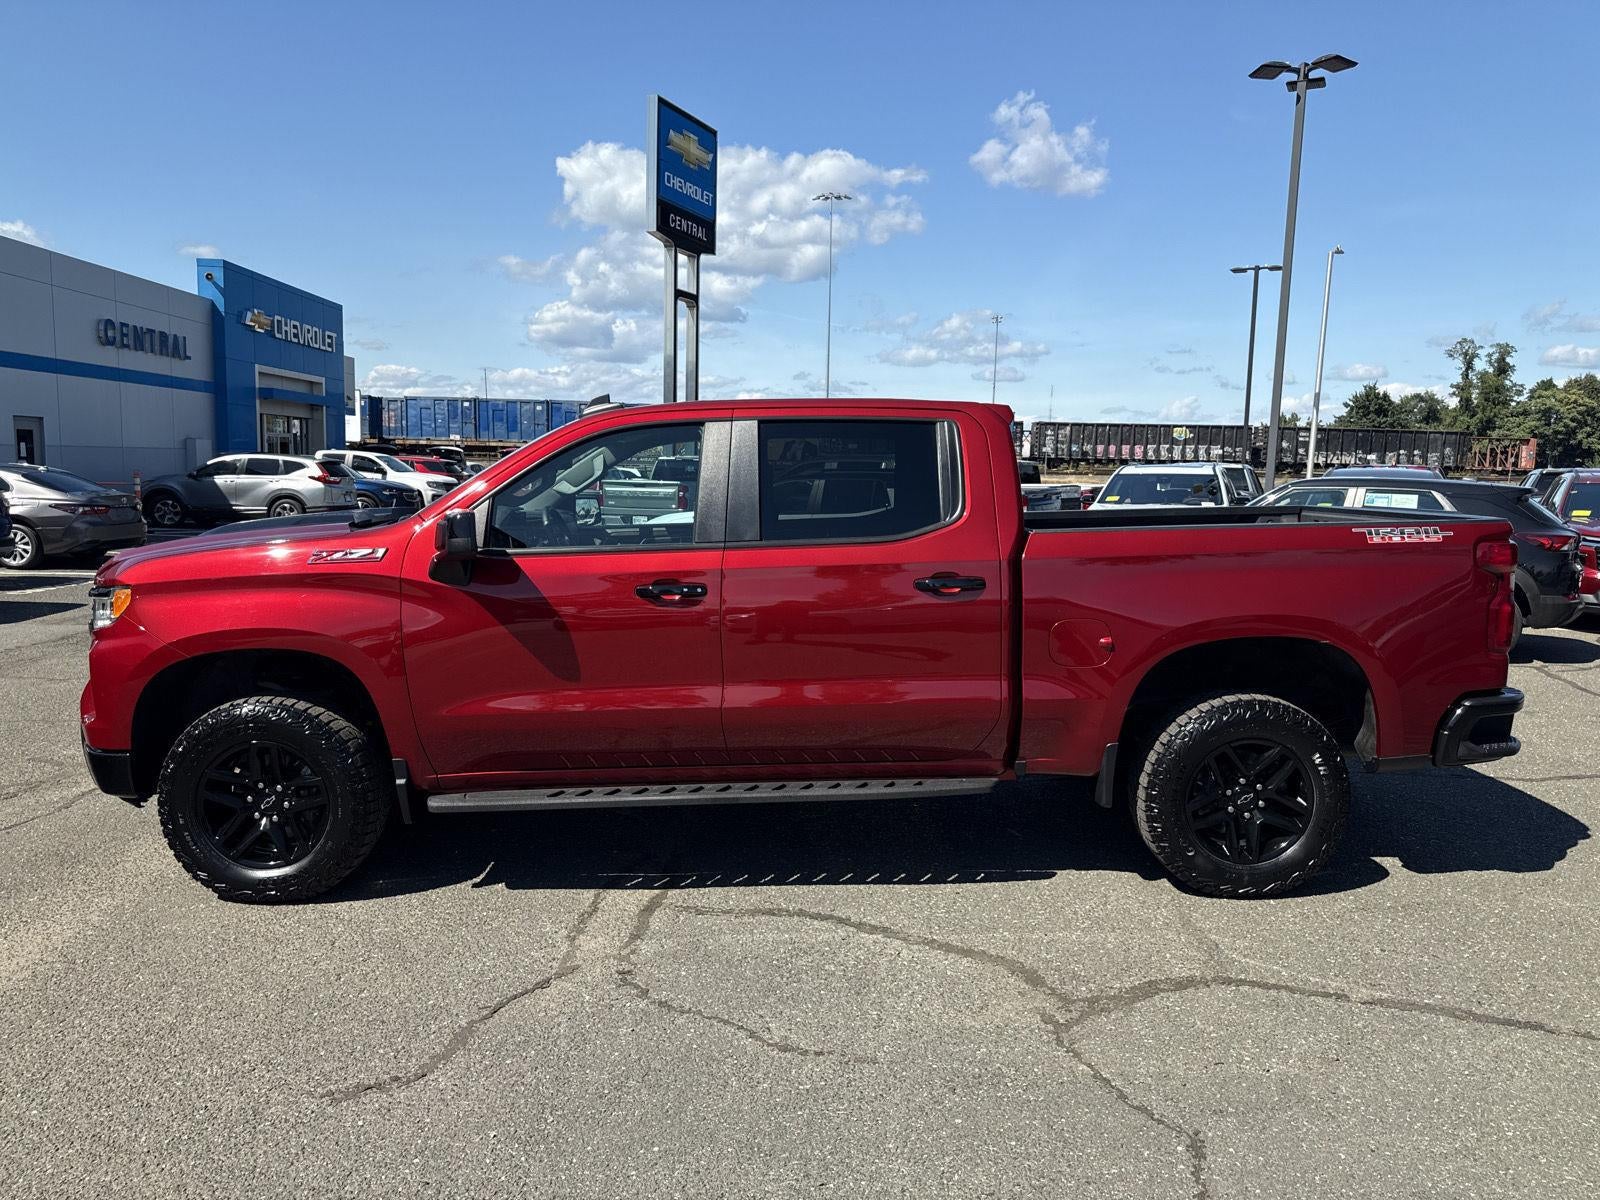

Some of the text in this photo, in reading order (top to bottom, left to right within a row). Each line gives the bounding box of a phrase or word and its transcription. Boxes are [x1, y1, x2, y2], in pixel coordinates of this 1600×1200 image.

[664, 171, 714, 207] CHEVROLET
[669, 213, 708, 241] CENTRAL
[97, 318, 192, 361] CENTRAL
[274, 314, 338, 353] CHEVROLET
[307, 547, 389, 565] Z71
